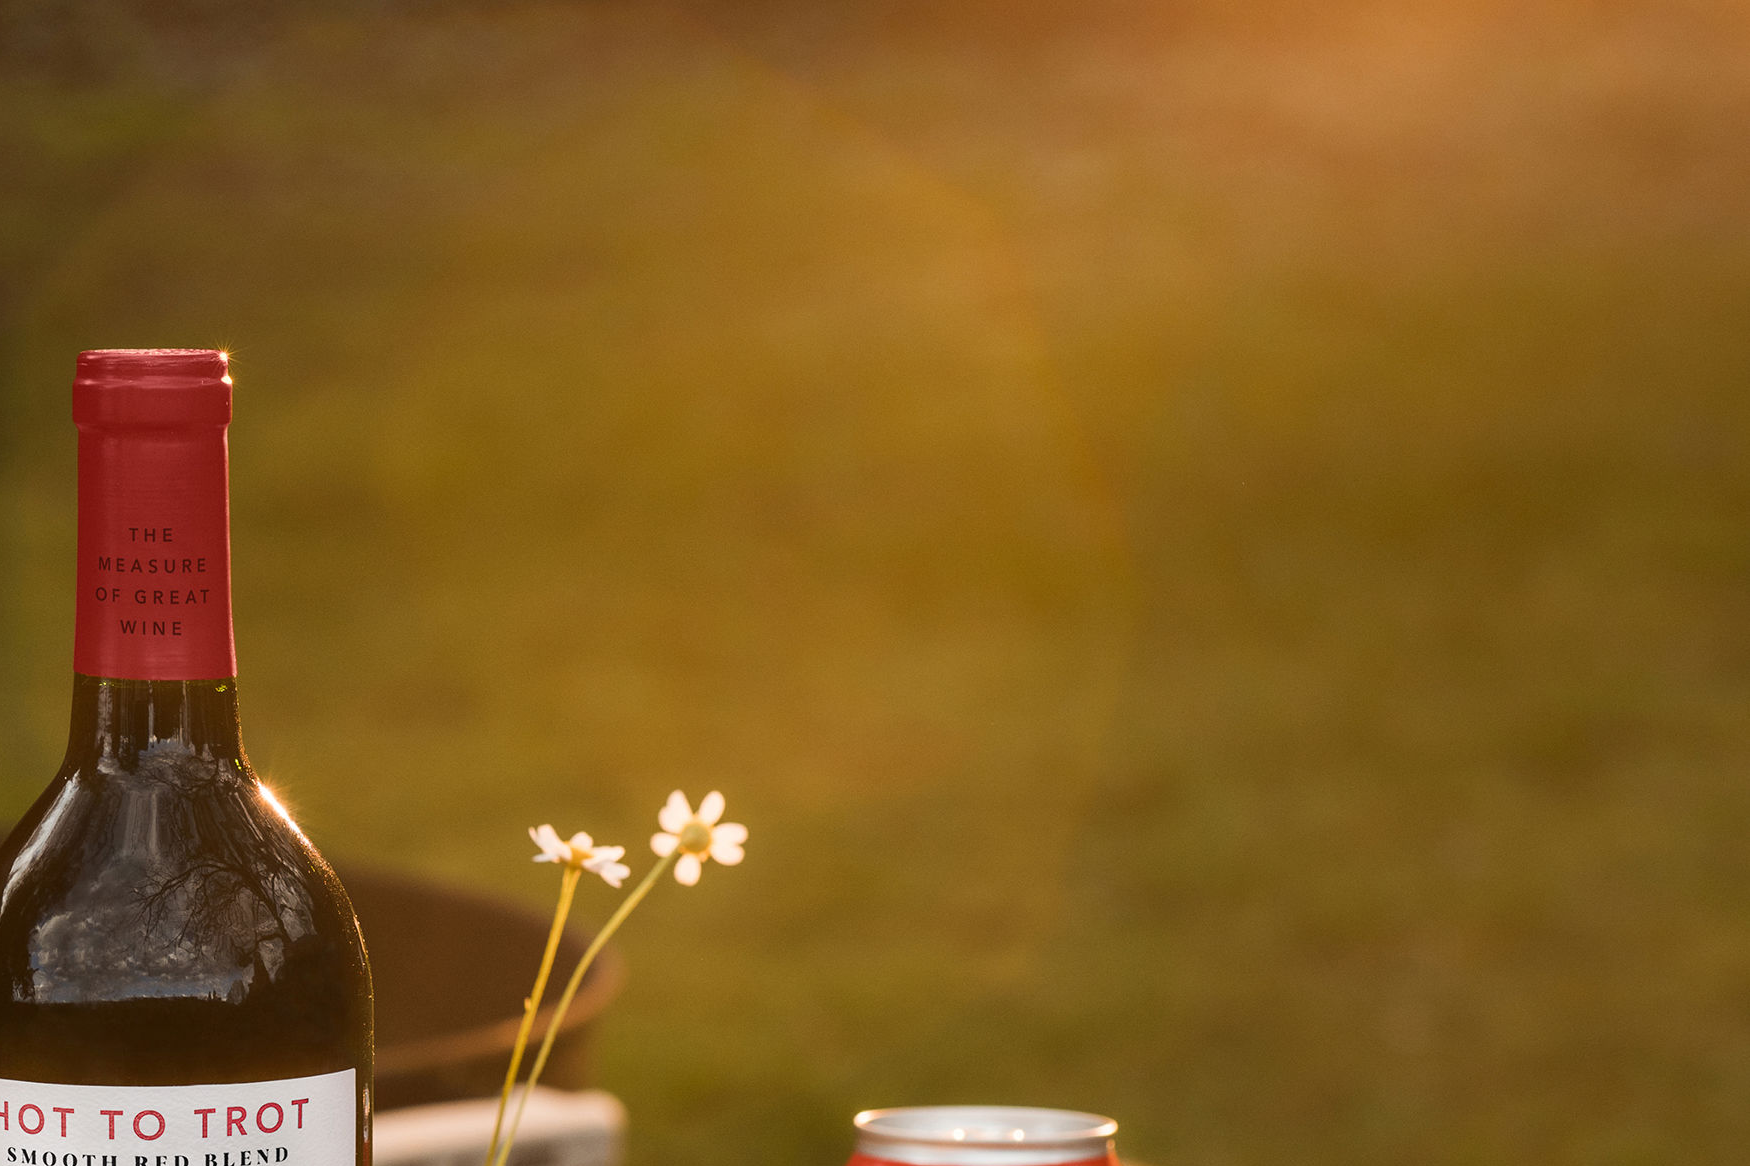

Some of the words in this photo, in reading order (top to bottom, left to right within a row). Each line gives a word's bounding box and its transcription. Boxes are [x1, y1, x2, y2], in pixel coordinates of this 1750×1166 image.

[128, 527, 173, 543] THE
[98, 556, 207, 574] MEASURE
[95, 587, 121, 602] OF
[134, 589, 210, 605] GREAT
[120, 620, 182, 636] WINE
[99, 1109, 166, 1141] TO
[193, 1097, 310, 1139] TROT
